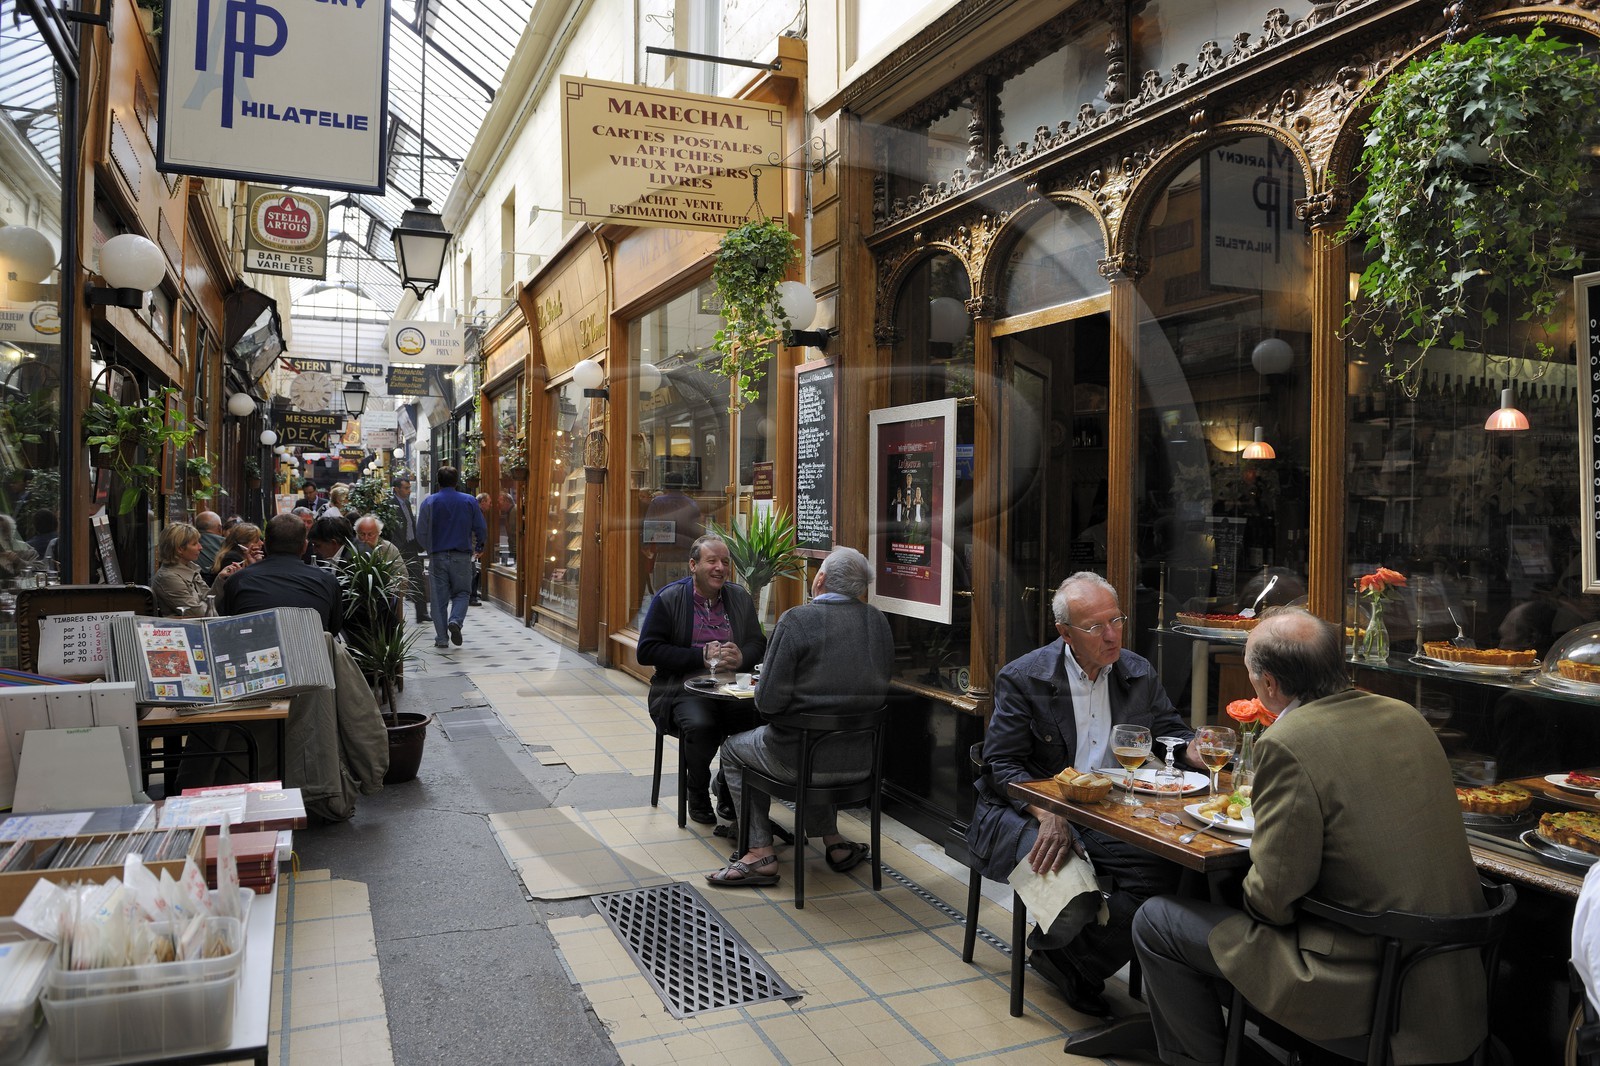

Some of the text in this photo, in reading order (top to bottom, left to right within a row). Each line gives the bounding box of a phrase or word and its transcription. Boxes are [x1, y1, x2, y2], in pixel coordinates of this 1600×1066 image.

[608, 97, 749, 130] MARECHAL
[592, 124, 763, 155] CARTES POSTALES
[636, 144, 724, 163] AFFICHES
[609, 154, 749, 180] VIEUX PAPIERS
[649, 173, 713, 189] LIVRES
[638, 193, 678, 207] ACHAT
[268, 211, 308, 224] STELLA
[609, 203, 688, 221] ESTIMATION
[267, 221, 308, 233] ARTOIS
[258, 252, 313, 265] BAR DES
[257, 260, 314, 273] VARIETES
[430, 339, 459, 347] MEILLEURS
[436, 348, 449, 356] PRIX
[294, 360, 327, 371] STERN
[345, 363, 380, 375] Graveur
[285, 415, 335, 425] MESSMER
